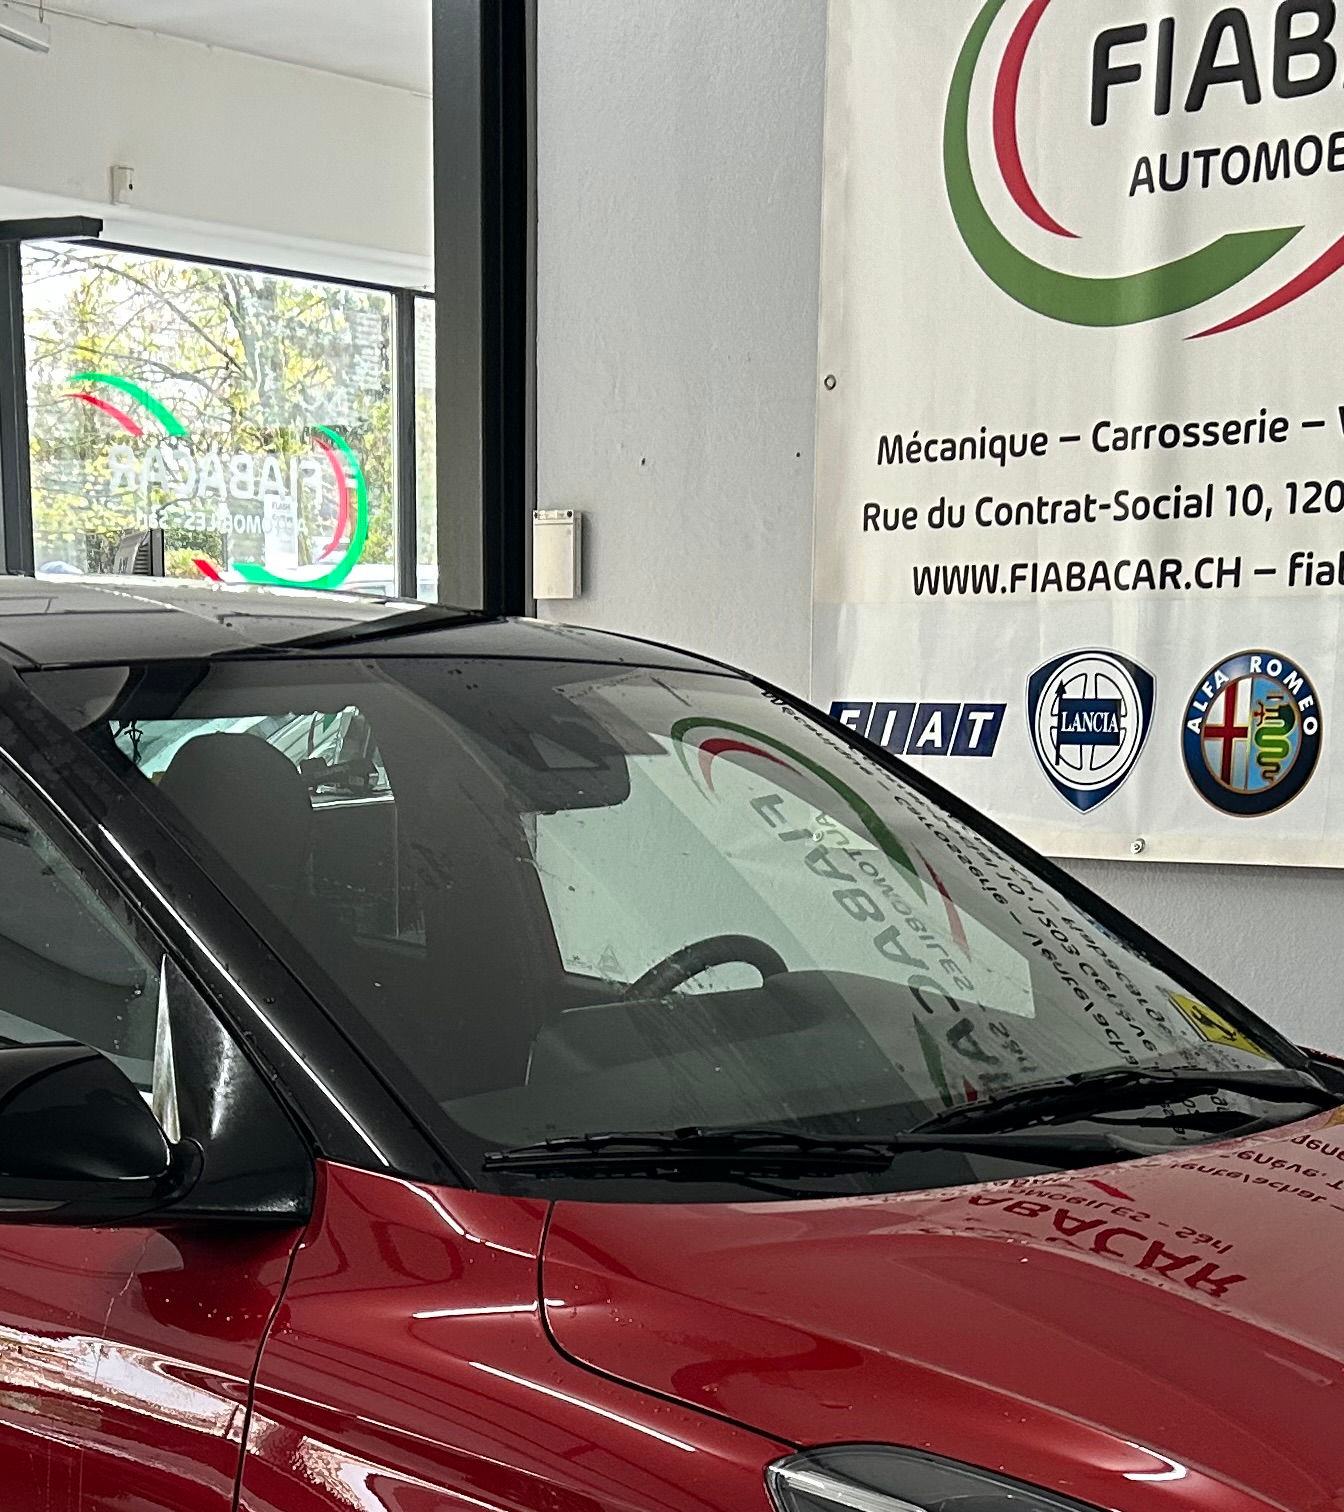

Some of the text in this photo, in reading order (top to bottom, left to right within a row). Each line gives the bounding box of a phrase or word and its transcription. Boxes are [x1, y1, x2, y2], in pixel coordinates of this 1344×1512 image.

[877, 427, 1048, 467] Mécanique
[1091, 408, 1290, 453] Carrosserie
[862, 501, 919, 532] Rue
[926, 497, 966, 528] du
[974, 483, 1214, 527] Contrat-Social
[1225, 482, 1273, 524] 10,
[912, 555, 1241, 596] WWW.FIABACAR.CH
[1186, 655, 1317, 737] ALFA ROMEO
[839, 708, 995, 749] FIAT
[1061, 711, 1120, 734] LANCIA
